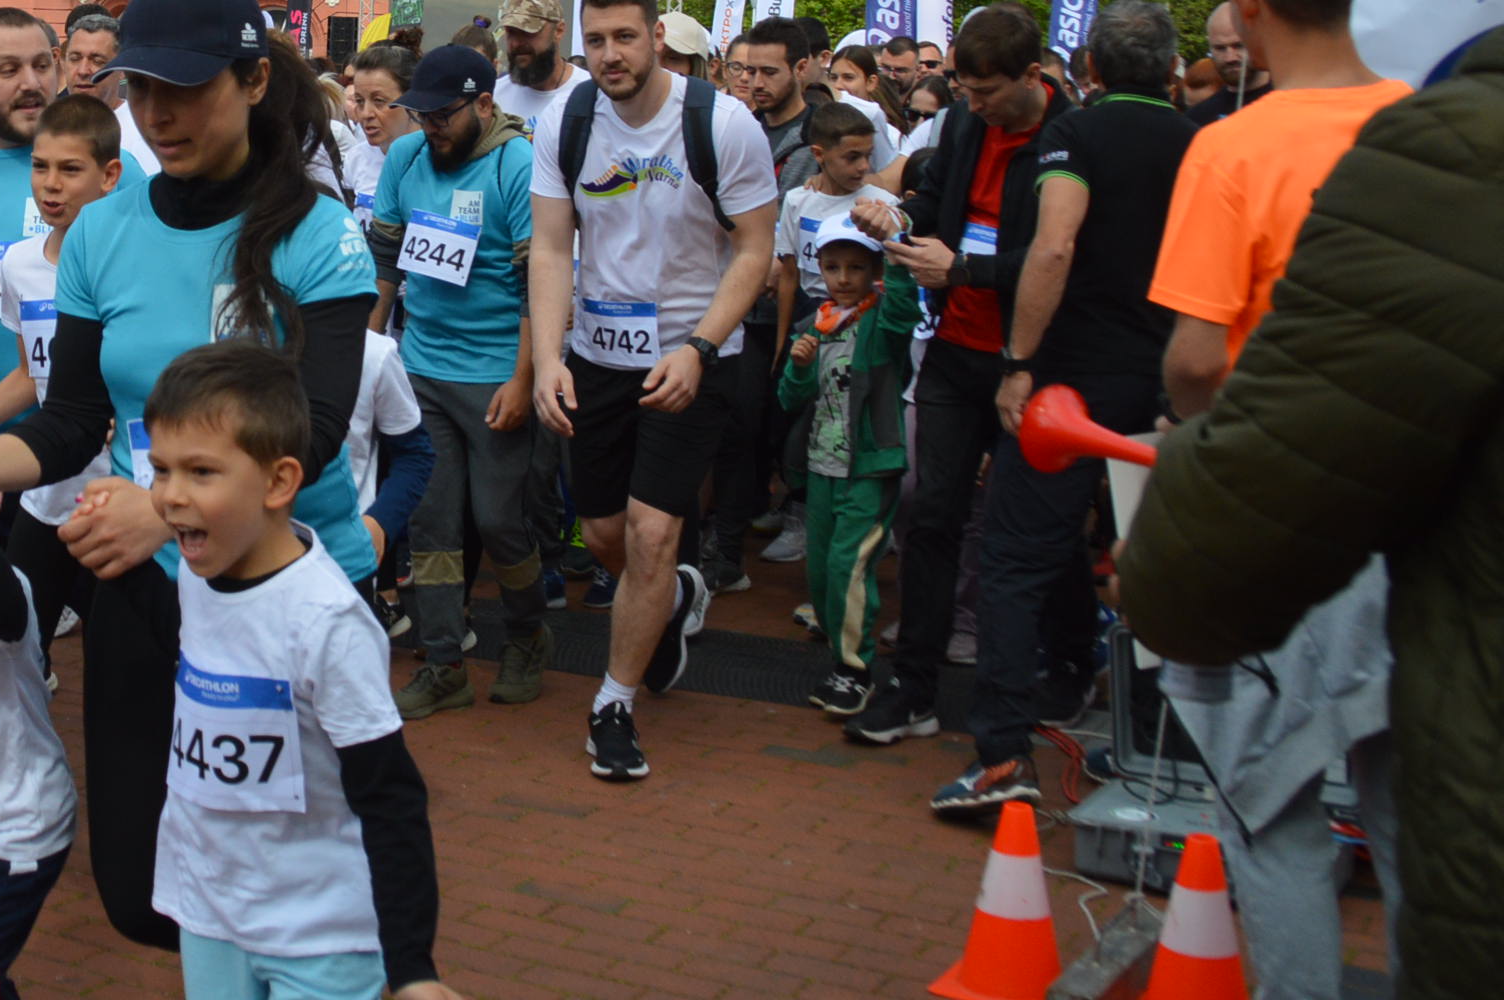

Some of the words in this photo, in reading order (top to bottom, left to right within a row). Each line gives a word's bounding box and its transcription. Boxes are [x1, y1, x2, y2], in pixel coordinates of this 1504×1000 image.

[458, 207, 481, 215] TEAM
[404, 236, 466, 272] 4244
[592, 326, 653, 355] 4742
[173, 717, 285, 786] 4437
